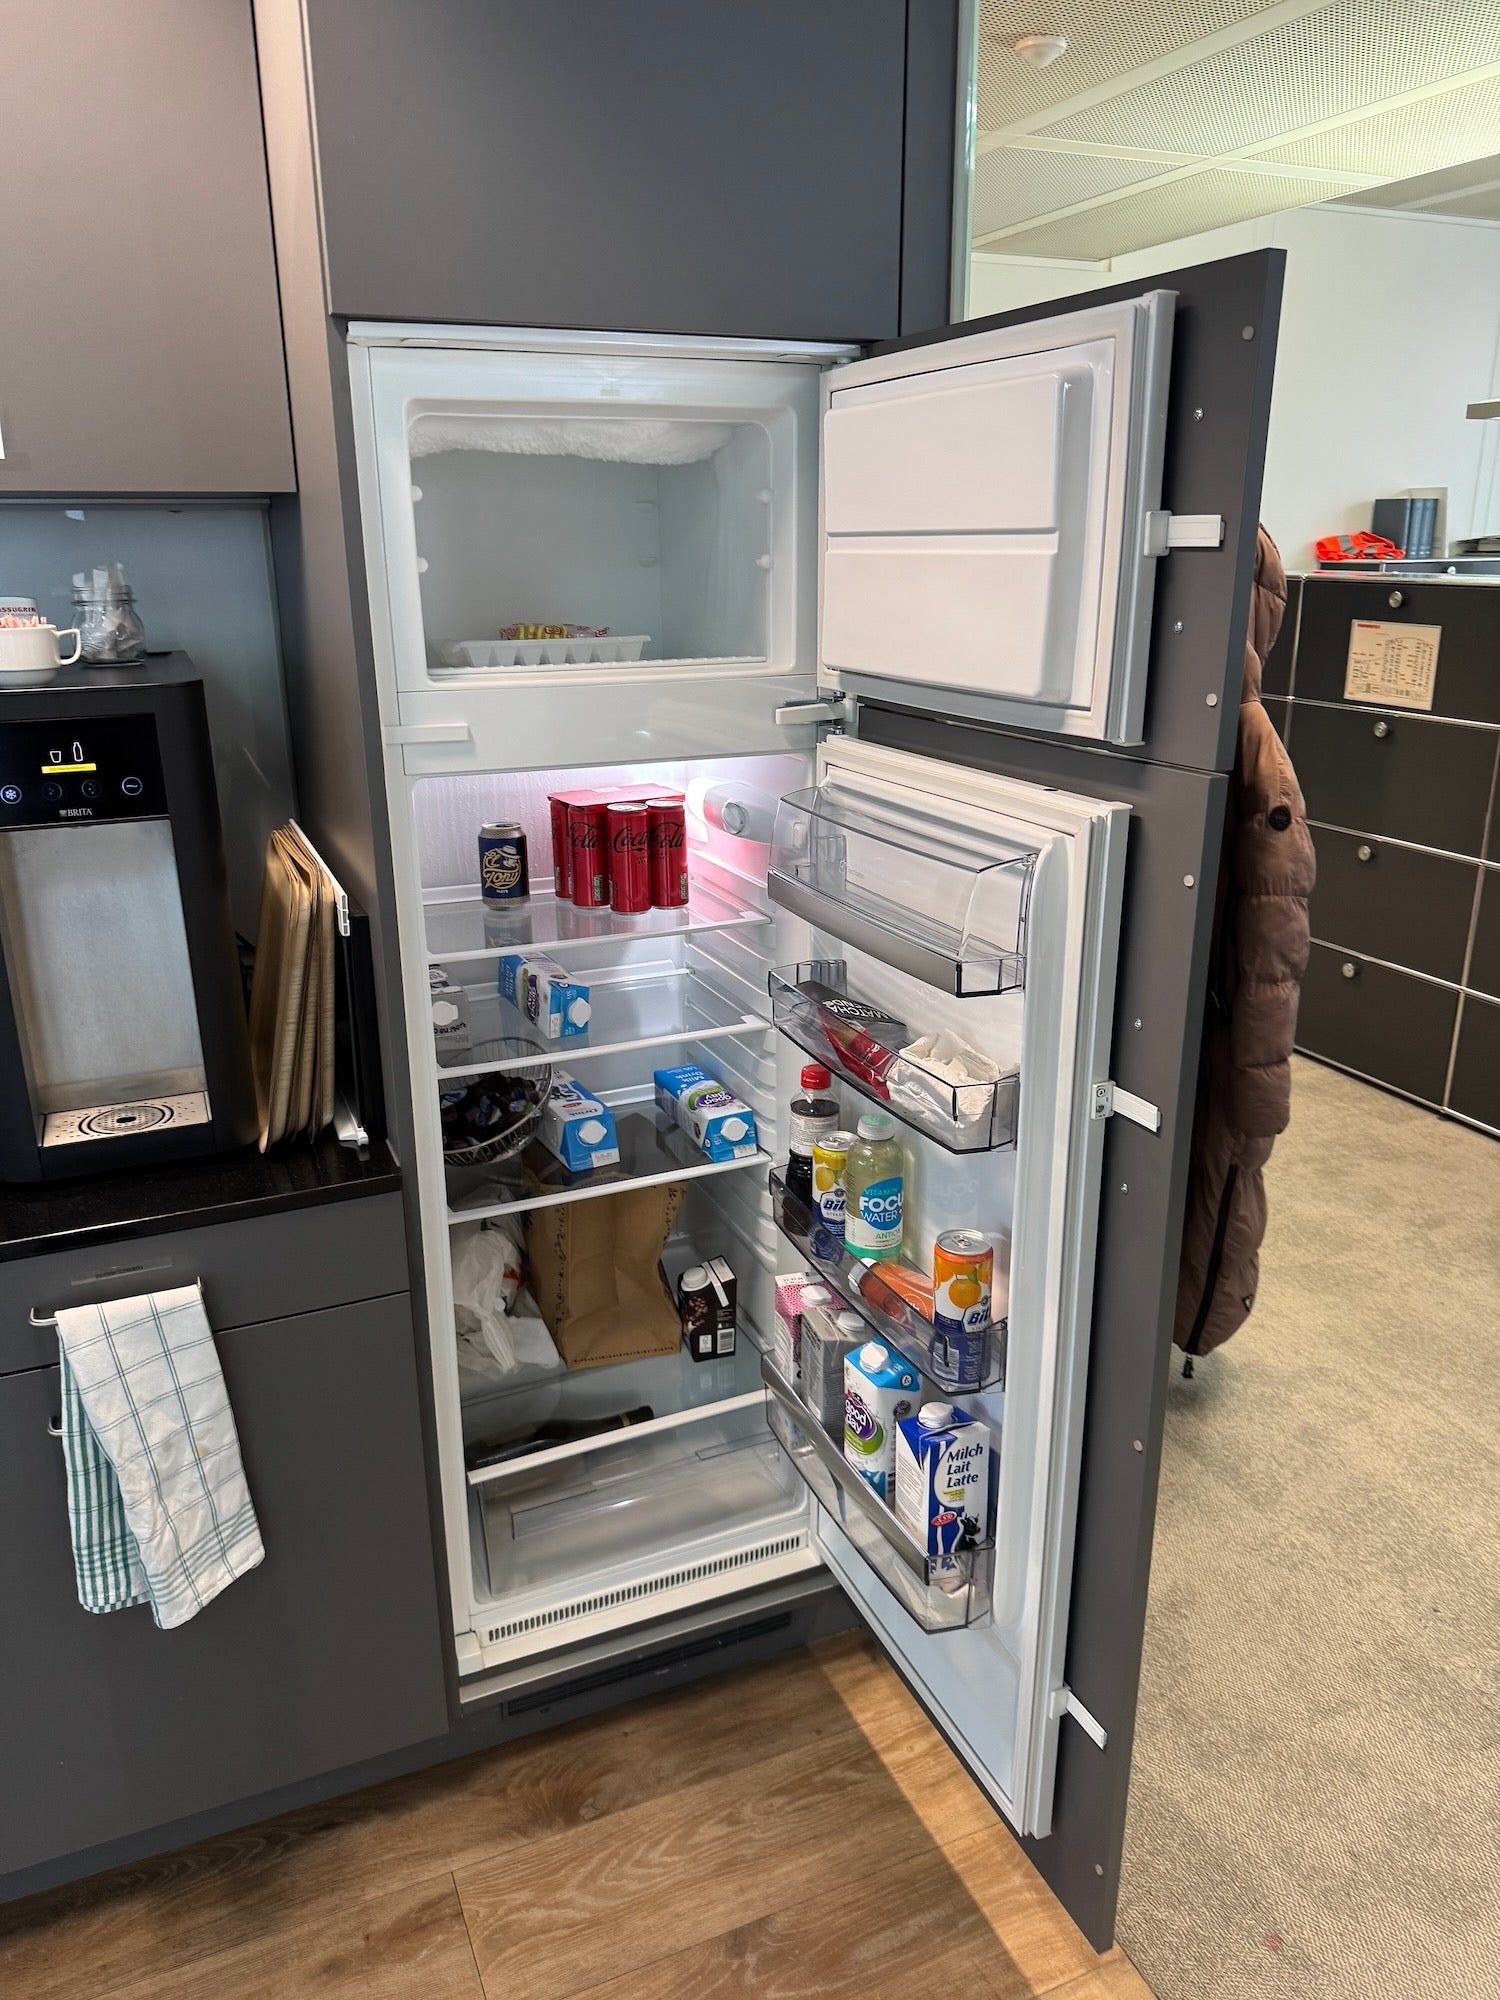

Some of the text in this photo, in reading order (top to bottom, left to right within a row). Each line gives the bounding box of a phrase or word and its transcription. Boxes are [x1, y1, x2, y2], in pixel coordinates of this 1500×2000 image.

[67, 808, 93, 817] BRITA
[483, 867, 520, 887] Tony
[828, 1004, 889, 1019] MATCHA
[704, 1094, 731, 1105] good
[861, 1210, 898, 1223] WATER
[845, 1400, 867, 1425] good
[846, 1414, 863, 1435] day
[946, 1443, 984, 1463] Milch
[946, 1460, 972, 1475] Lait
[946, 1473, 979, 1488] Latte
